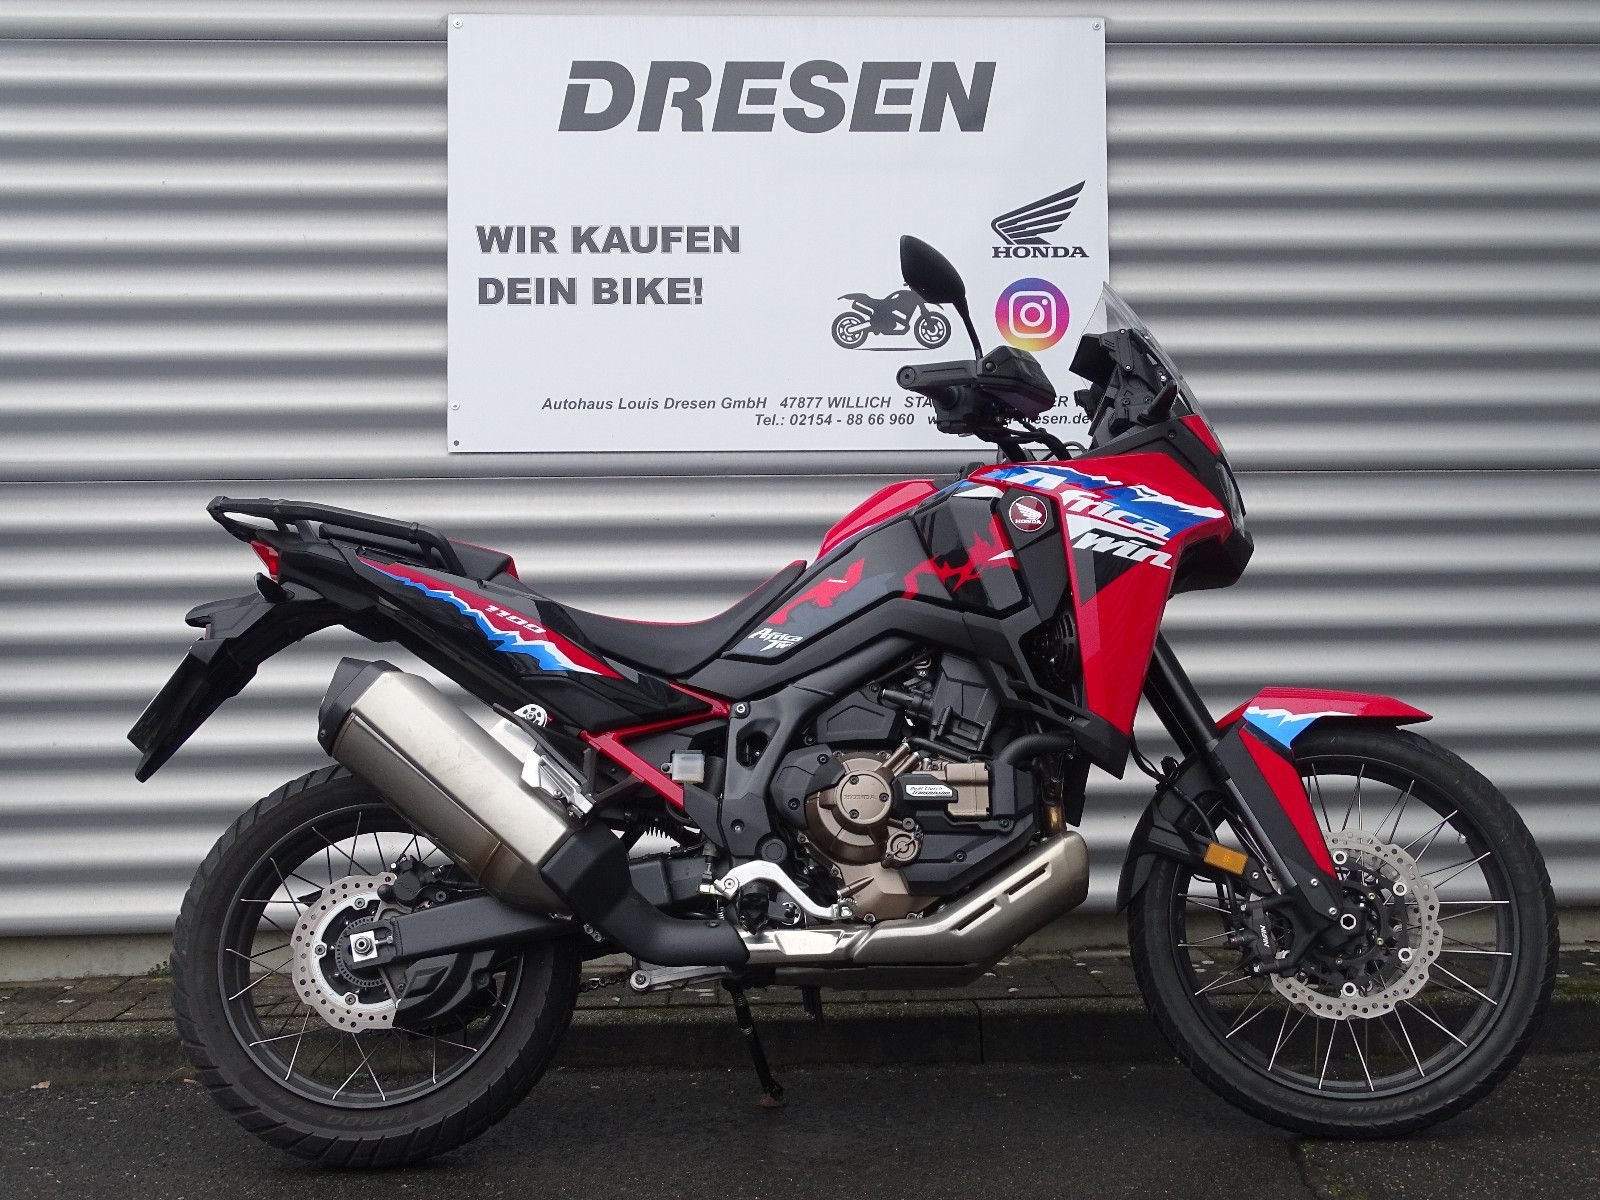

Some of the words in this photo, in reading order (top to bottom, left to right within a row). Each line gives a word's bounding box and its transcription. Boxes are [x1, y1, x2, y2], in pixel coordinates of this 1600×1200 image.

[557, 59, 997, 134] DRESEN
[475, 225, 557, 254] WIR
[571, 225, 741, 254] KAUFEN
[992, 245, 1089, 259] HONDA
[477, 277, 577, 306] DEIN
[592, 277, 704, 306] BIKE!
[541, 397, 614, 410] Autohaus
[618, 397, 660, 410] Louis
[664, 397, 716, 409] Dresen
[721, 396, 767, 409] GmbH
[779, 396, 823, 409] 47877
[827, 396, 891, 408] WILLICH
[755, 413, 785, 426] Tel.:
[789, 413, 833, 426] 02154
[846, 413, 864, 426] 88
[867, 413, 885, 426] 66
[889, 413, 915, 426] 960
[484, 604, 547, 634] 1100
